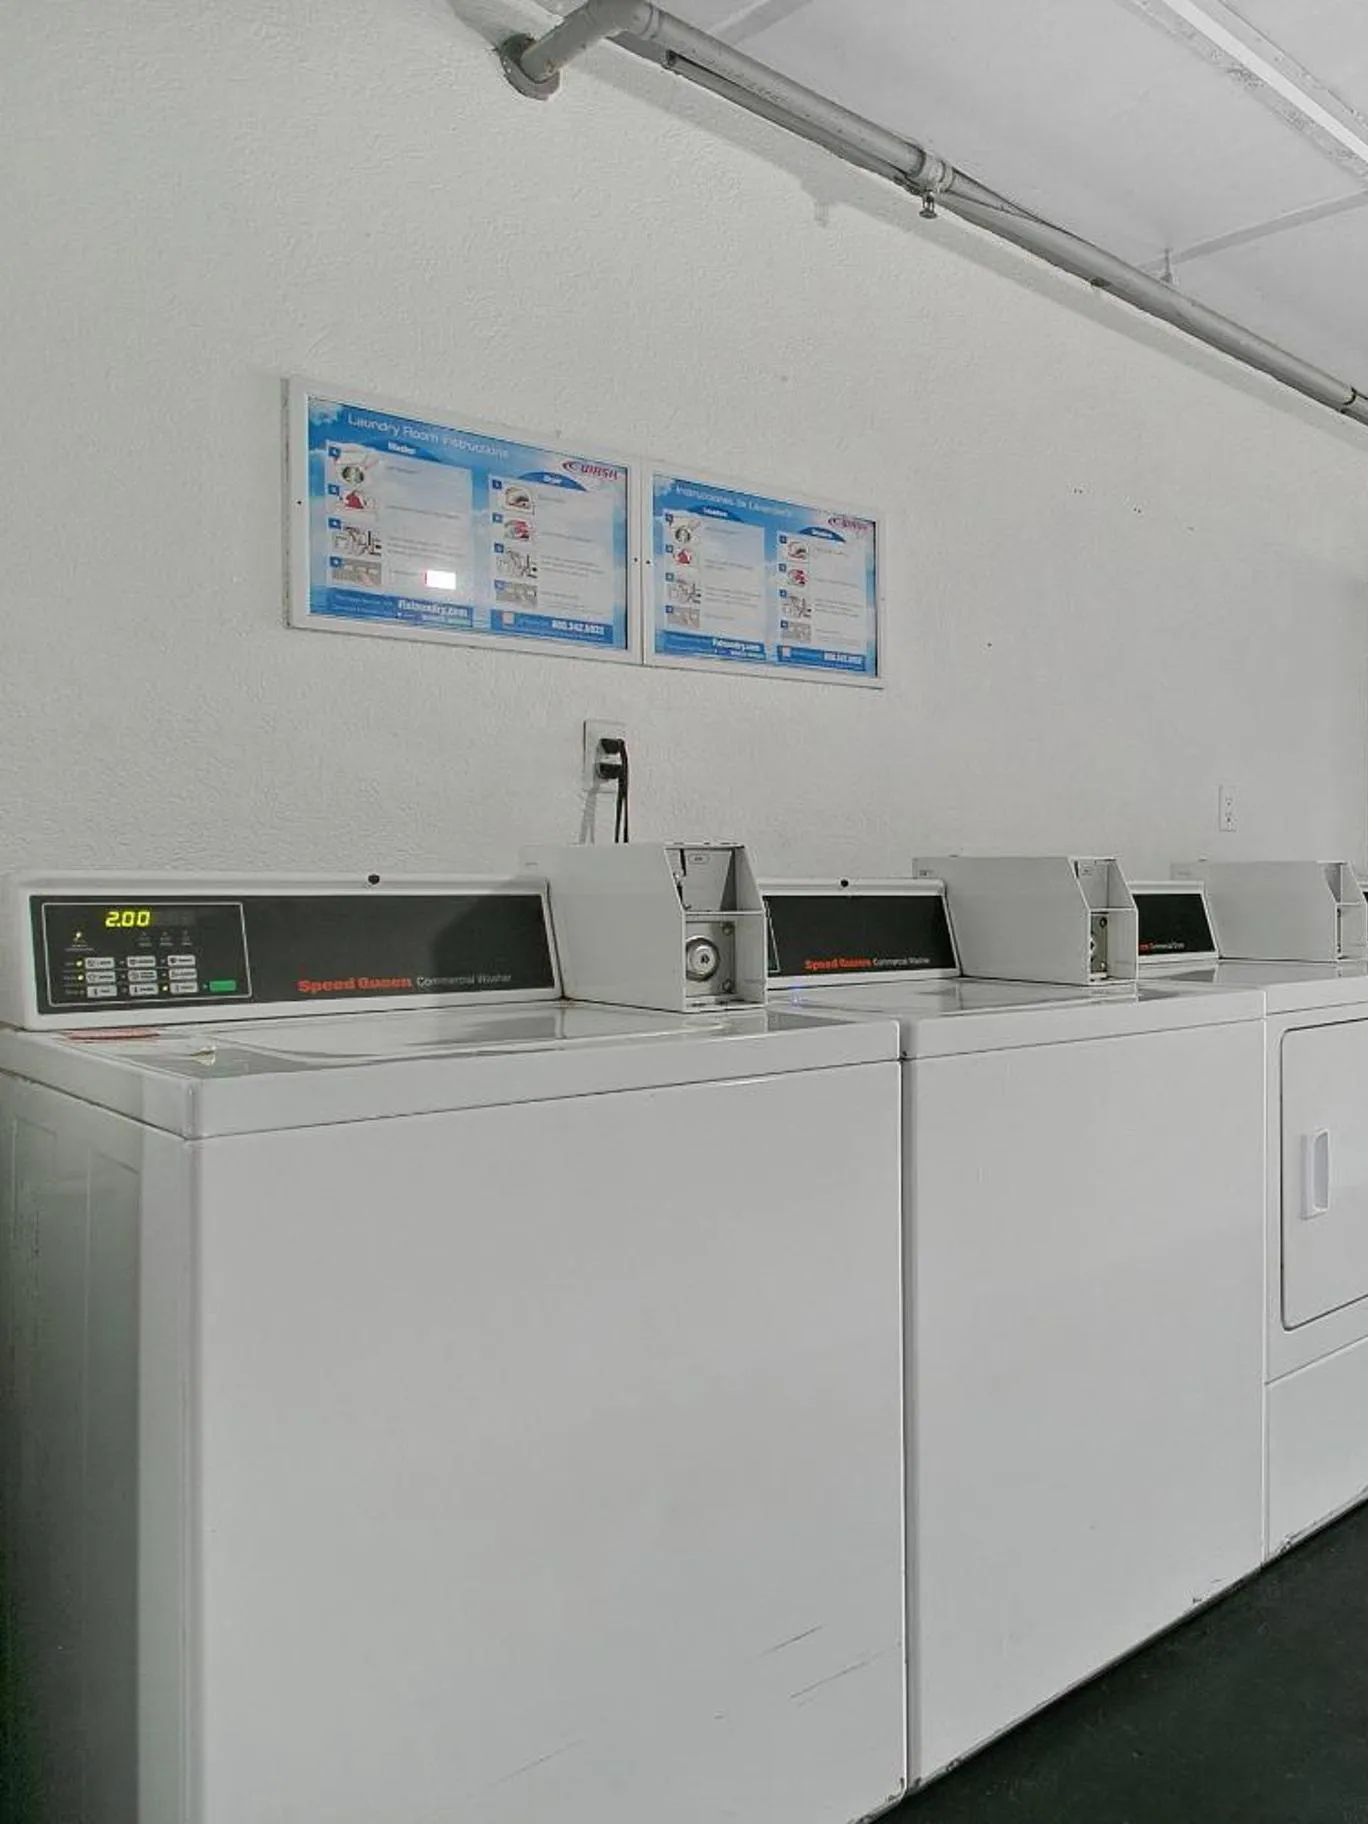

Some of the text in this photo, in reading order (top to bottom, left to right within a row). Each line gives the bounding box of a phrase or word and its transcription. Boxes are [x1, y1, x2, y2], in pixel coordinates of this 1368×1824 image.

[347, 413, 400, 437] Laundry
[402, 425, 439, 445] Room
[105, 911, 151, 928] 2.00
[298, 977, 355, 995] Speed
[357, 976, 414, 991] Queen
[416, 974, 475, 987] Commercial
